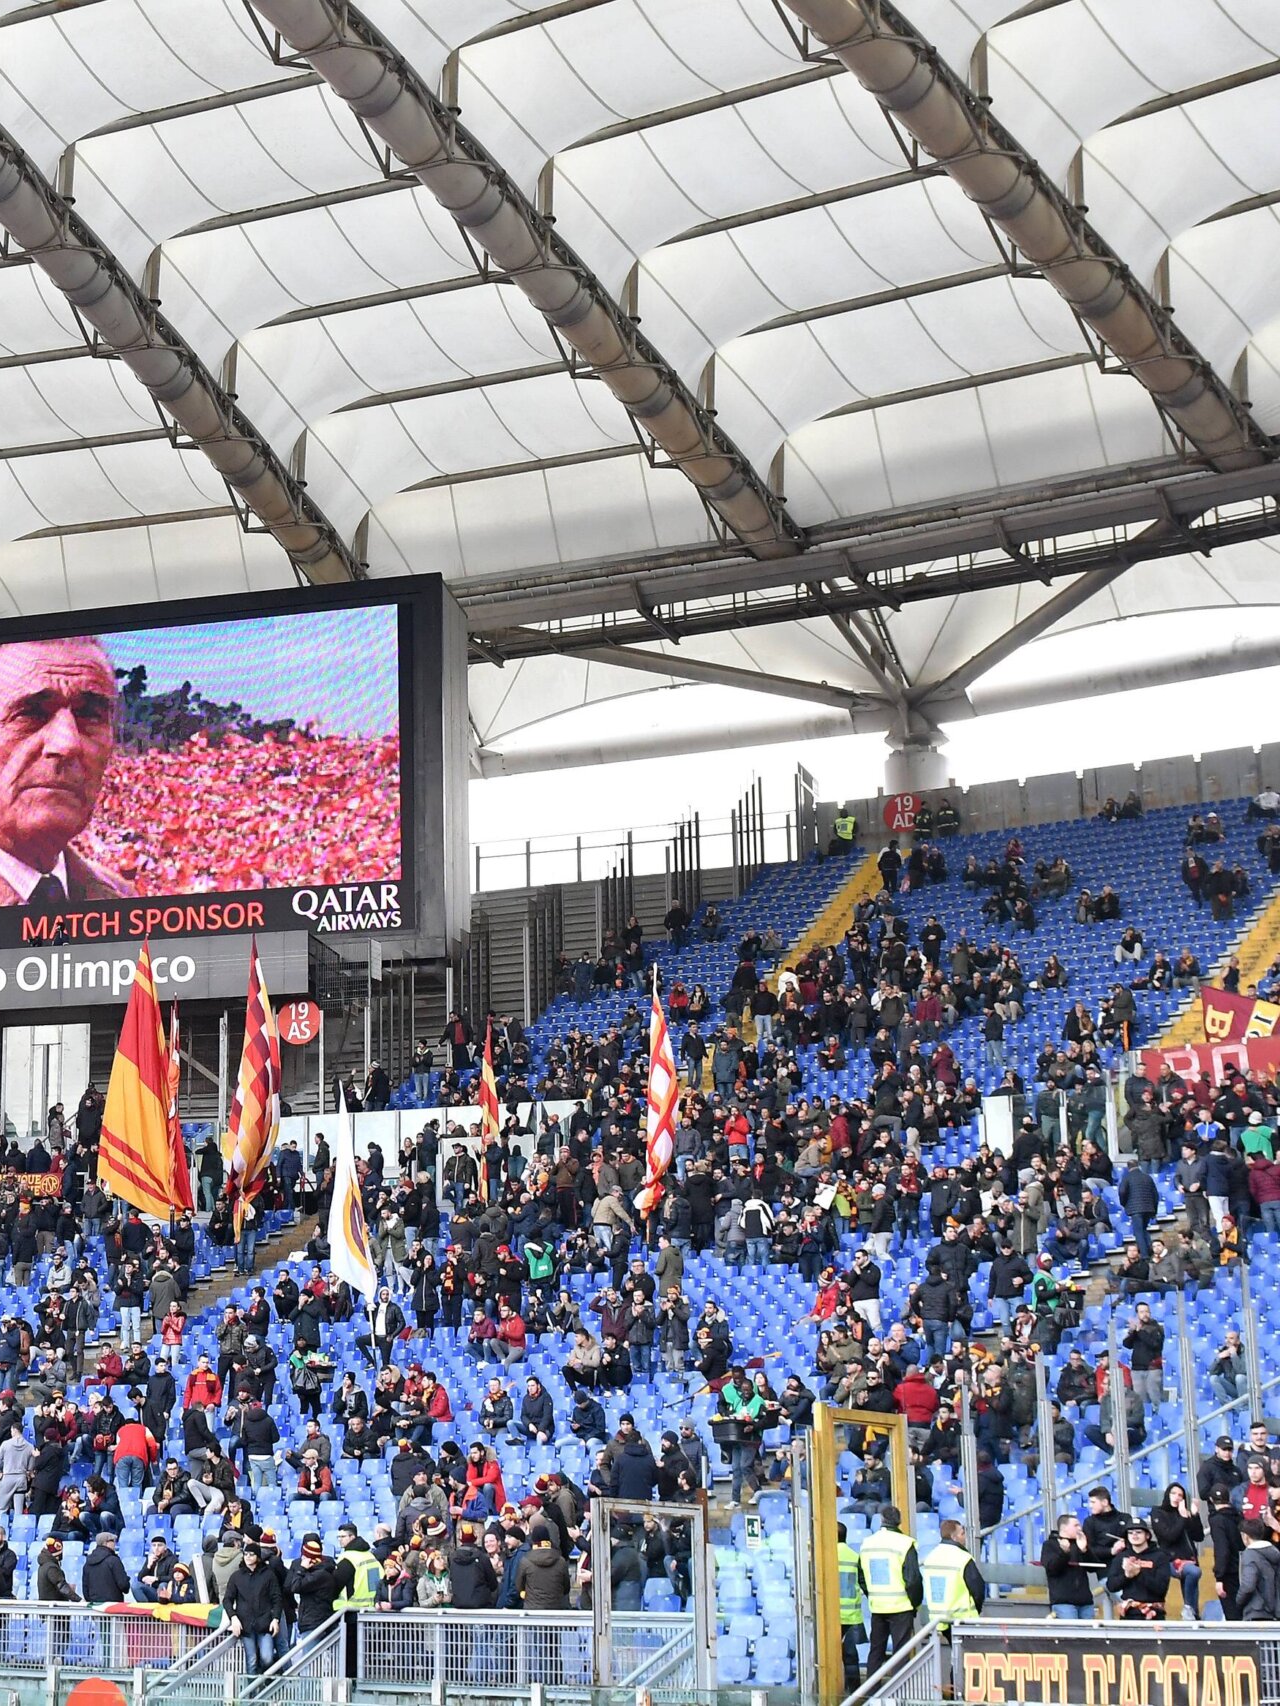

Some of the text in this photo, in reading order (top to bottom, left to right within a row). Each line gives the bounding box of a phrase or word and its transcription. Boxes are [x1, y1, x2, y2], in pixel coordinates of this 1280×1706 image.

[895, 796, 913, 812] 19
[292, 884, 400, 920] QATAR
[22, 901, 265, 941] MATCH SPONSOR
[317, 911, 402, 932] AIRWAYS
[16, 952, 196, 996] Olimpco
[288, 1002, 309, 1020] 19
[287, 1021, 311, 1040] AS
